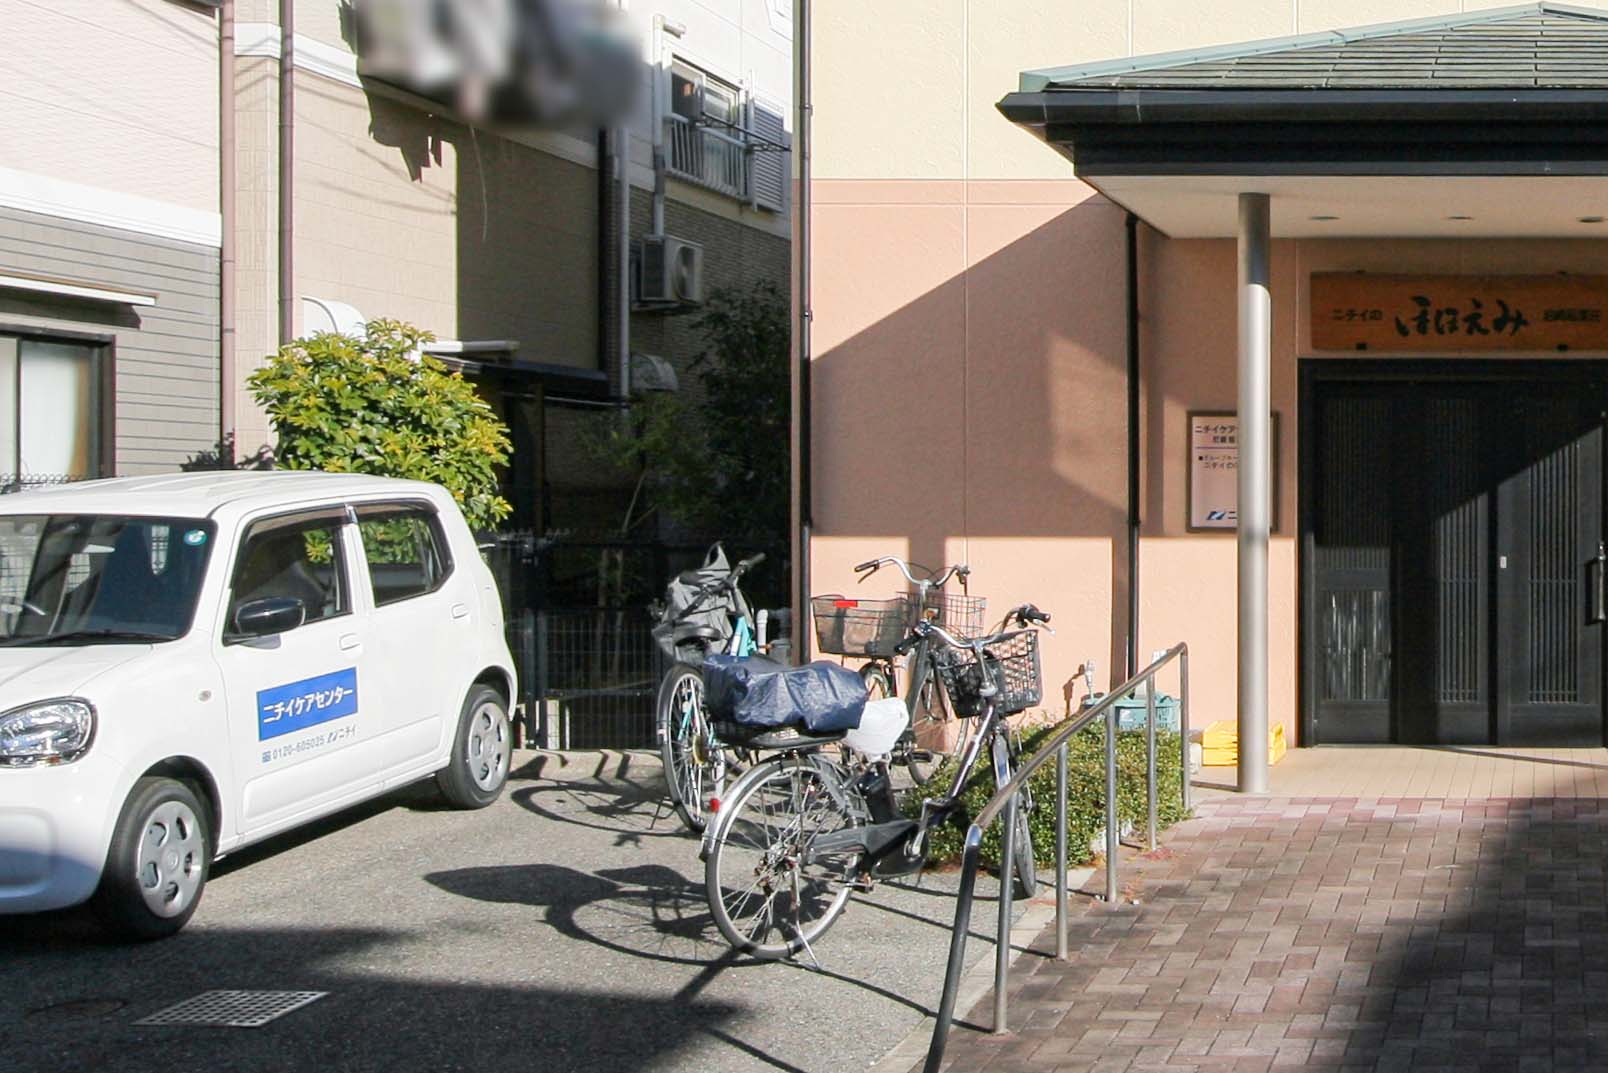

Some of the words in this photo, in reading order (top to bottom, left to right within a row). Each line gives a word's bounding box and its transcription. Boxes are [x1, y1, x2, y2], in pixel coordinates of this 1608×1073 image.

[1332, 308, 1383, 321] ニチイの
[1195, 425, 1238, 433] ニチイケア
[263, 685, 353, 723] ニチイケアセンター
